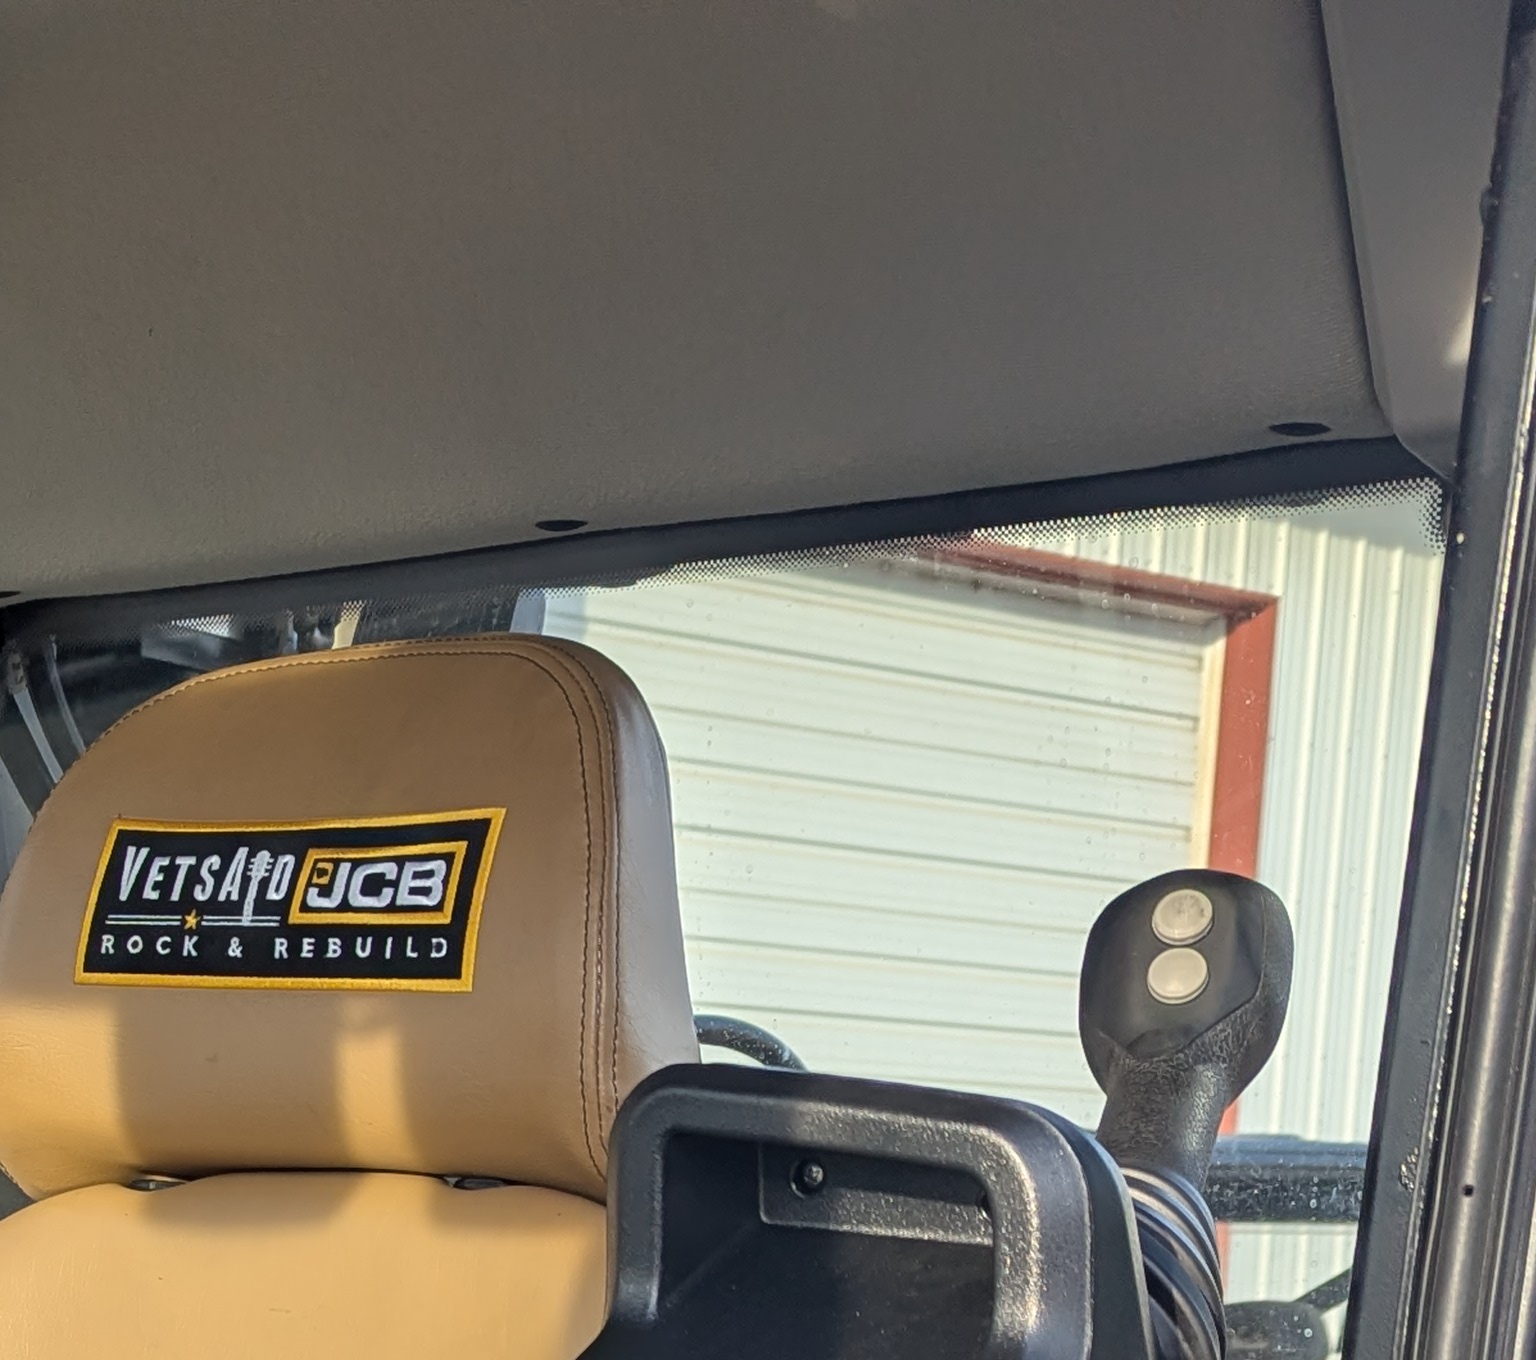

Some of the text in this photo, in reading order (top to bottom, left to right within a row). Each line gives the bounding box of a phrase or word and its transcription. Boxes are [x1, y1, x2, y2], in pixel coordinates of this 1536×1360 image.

[305, 858, 449, 909] JCB
[100, 934, 449, 960] ROCK & REBUILD
